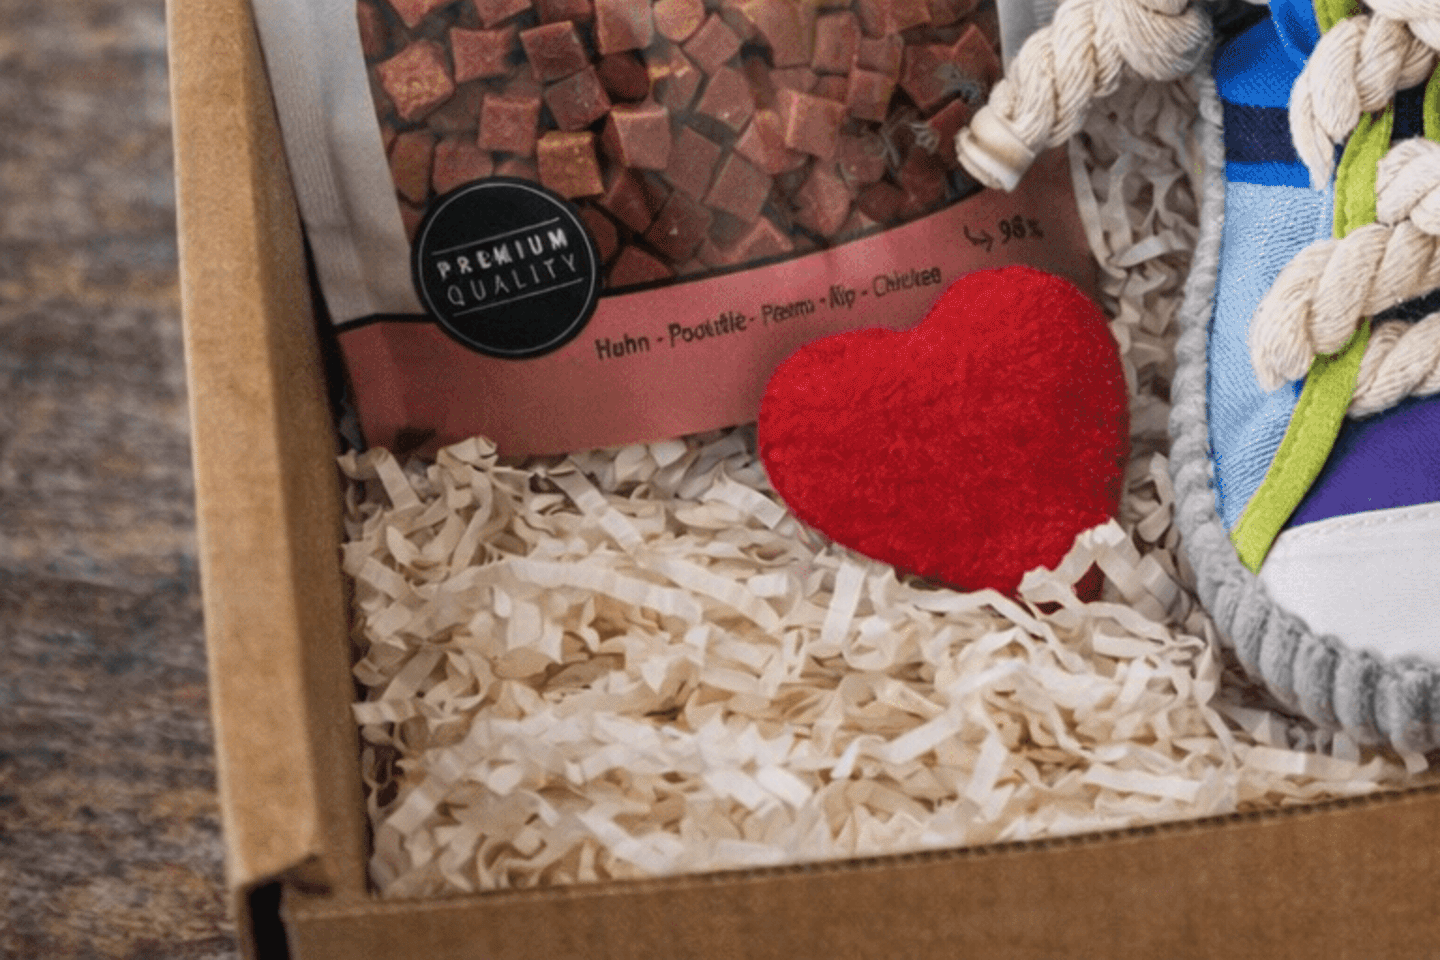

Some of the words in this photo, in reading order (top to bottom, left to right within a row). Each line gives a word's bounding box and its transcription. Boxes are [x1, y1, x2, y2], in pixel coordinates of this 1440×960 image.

[437, 228, 568, 282] PREMIUM
[447, 253, 576, 307] QUALITY
[594, 333, 651, 359] Huhn
